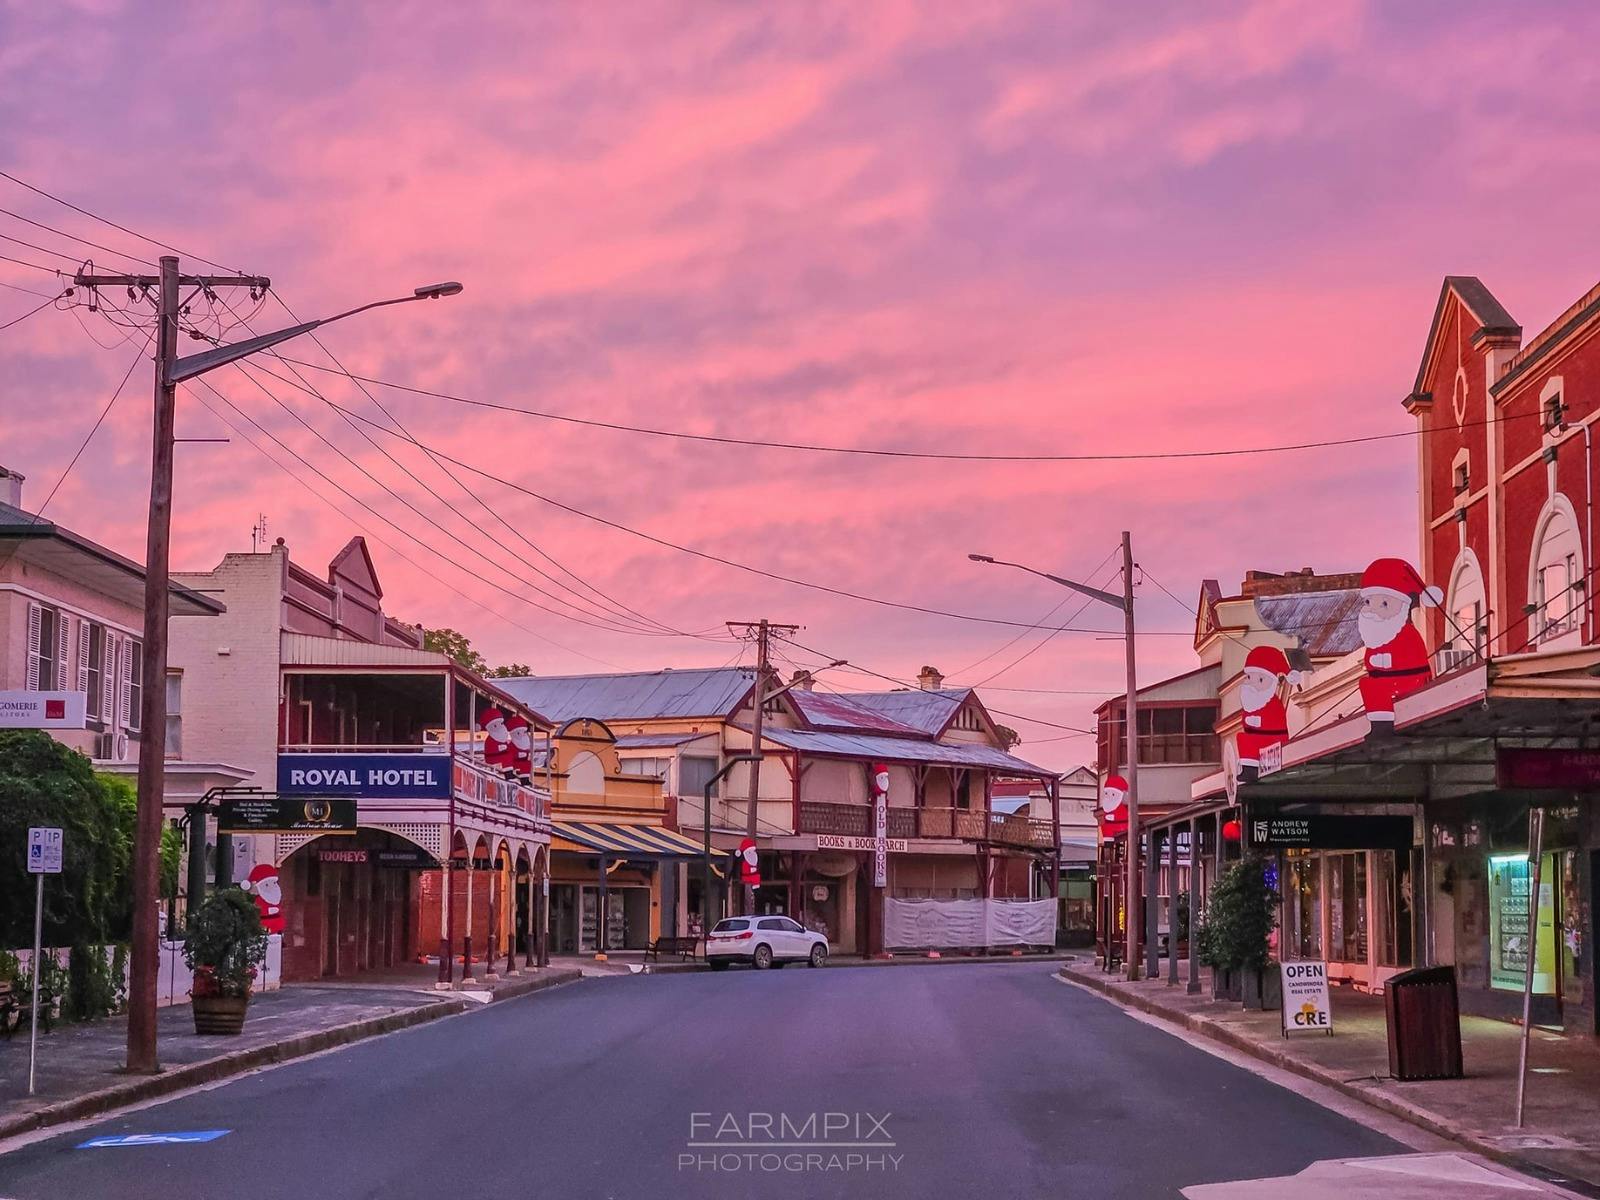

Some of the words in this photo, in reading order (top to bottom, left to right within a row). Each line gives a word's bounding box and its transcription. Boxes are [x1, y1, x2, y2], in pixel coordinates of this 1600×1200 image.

[290, 769, 361, 785] ROYAL
[368, 769, 438, 785] HOTEL
[877, 805, 885, 829] OLD
[33, 831, 41, 843] P
[48, 832, 60, 843] 1P
[818, 836, 845, 847] BOOKS
[855, 838, 876, 849] BOOK
[319, 851, 367, 862] TOOHEYS
[1286, 965, 1322, 978] OPEN
[1294, 1011, 1327, 1026] CRE
